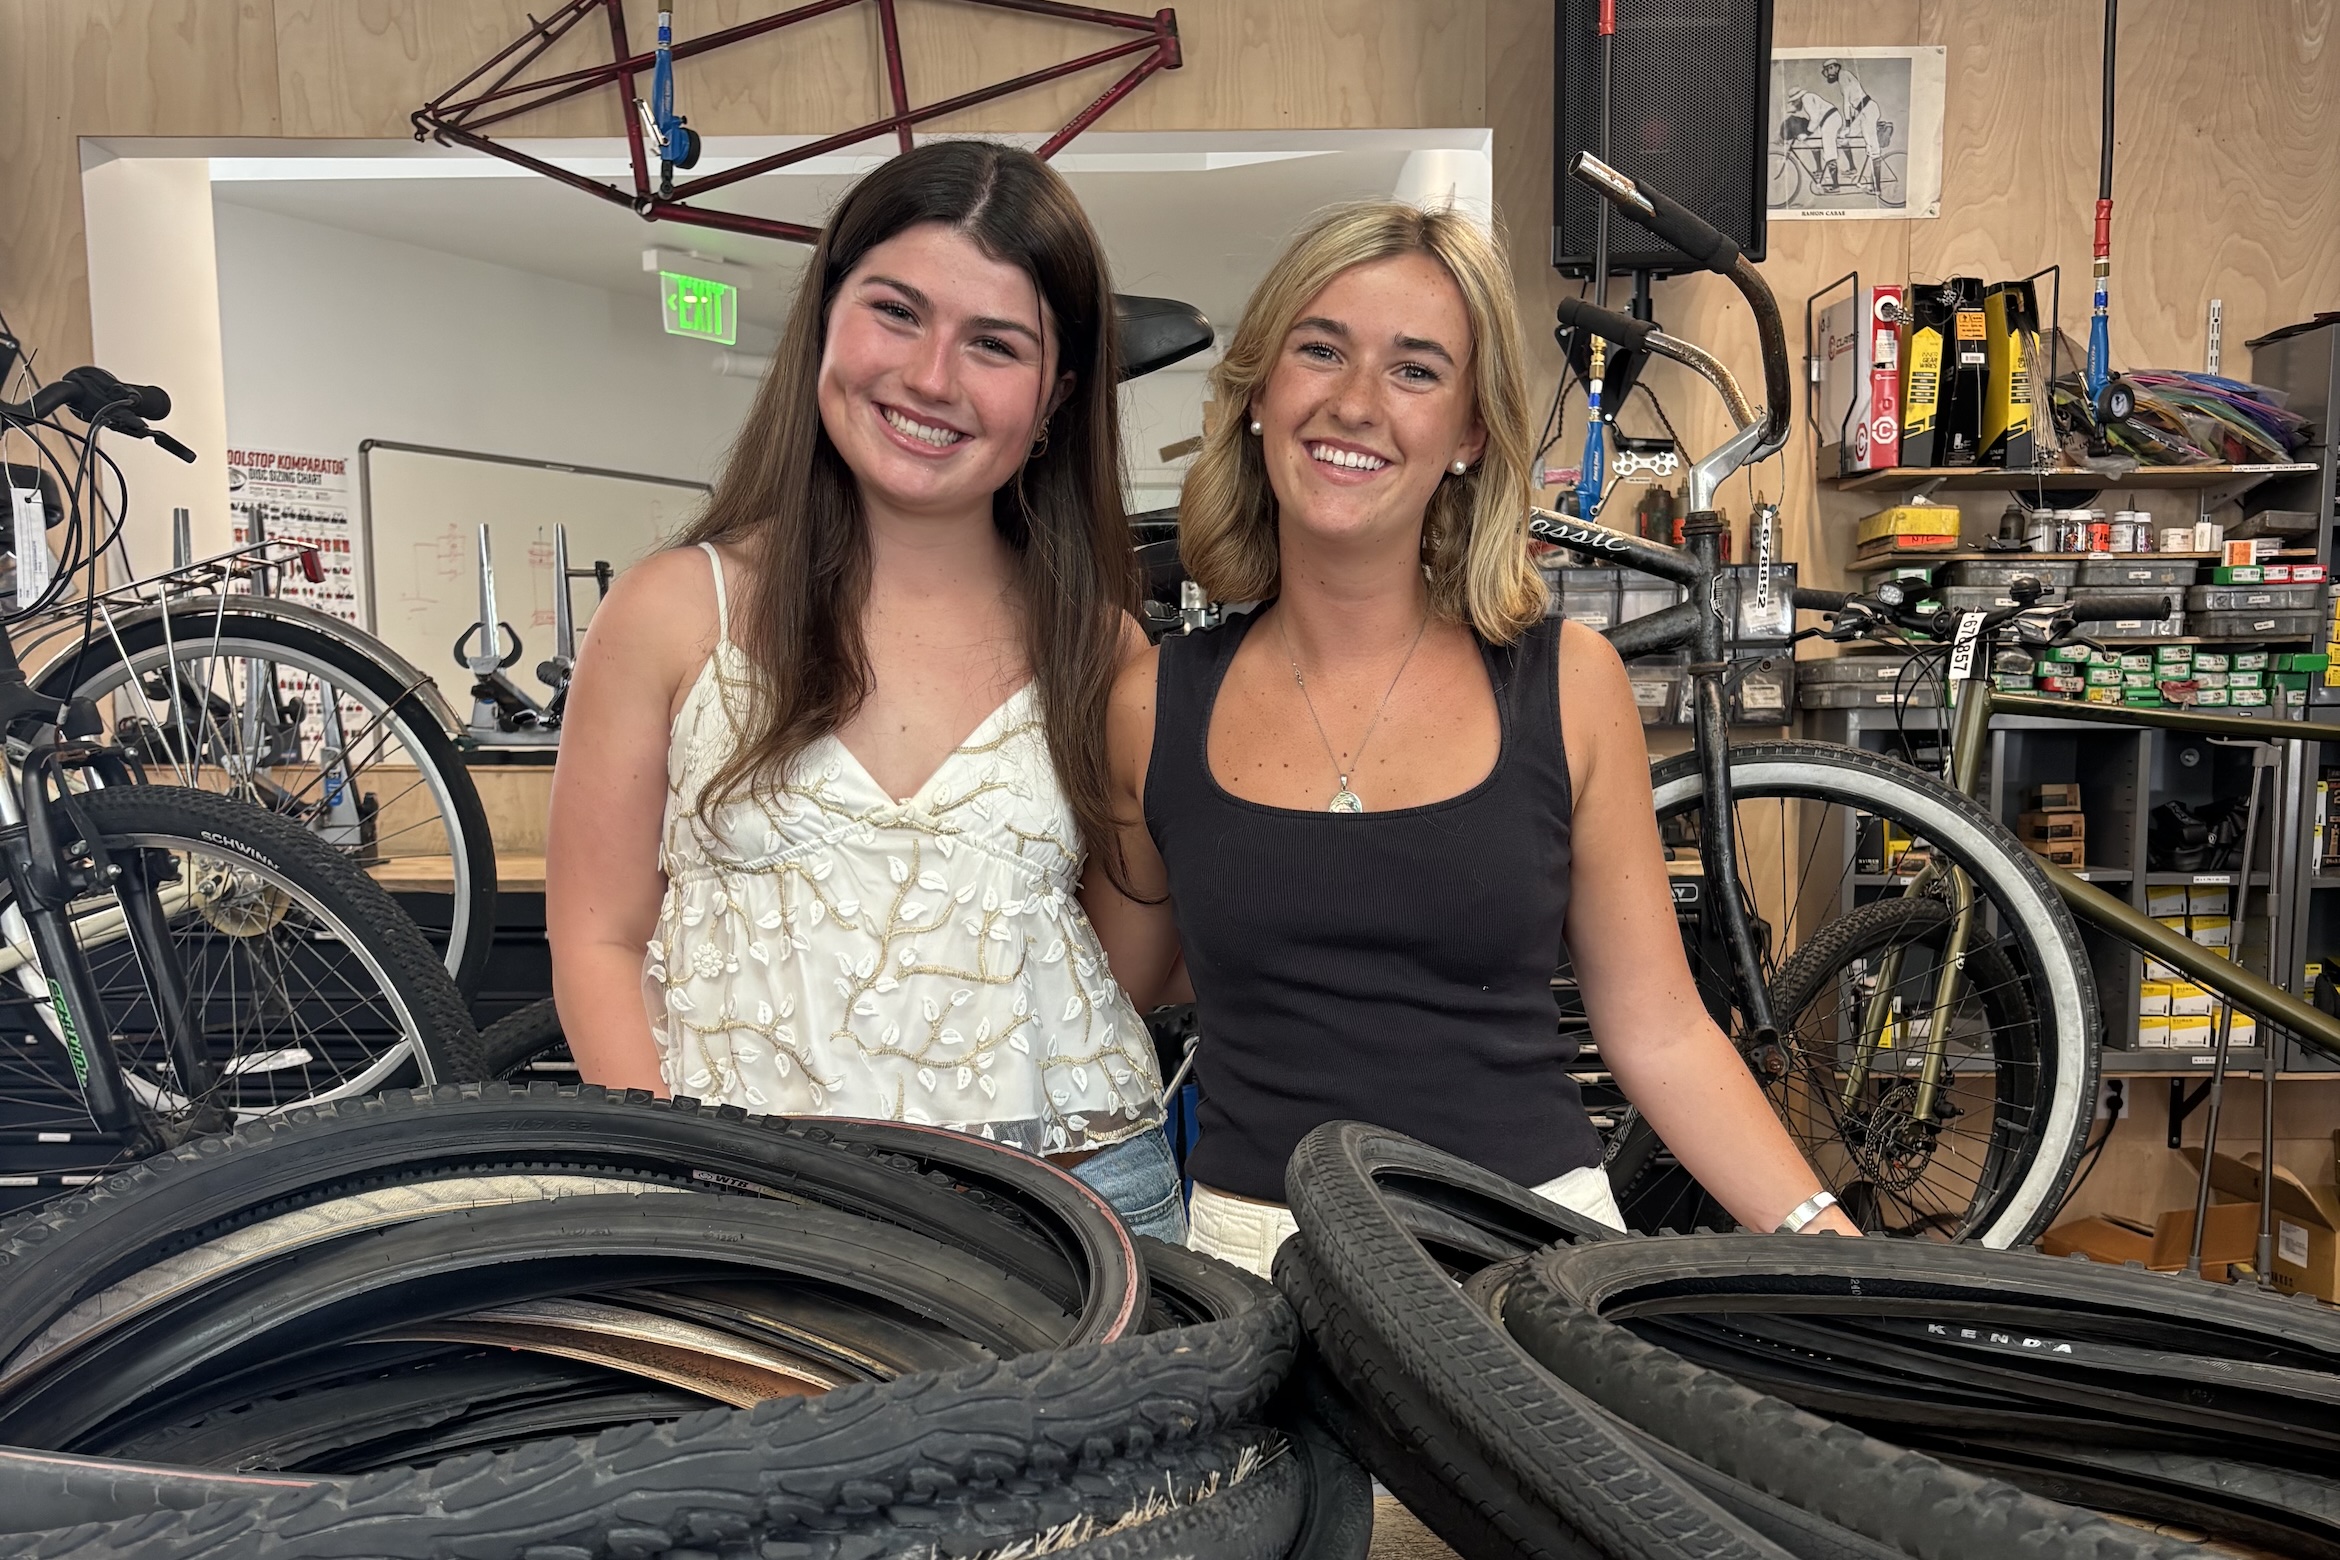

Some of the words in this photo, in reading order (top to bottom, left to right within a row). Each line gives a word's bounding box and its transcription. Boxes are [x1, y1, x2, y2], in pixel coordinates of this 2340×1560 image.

[679, 276, 725, 335] EXIT
[248, 467, 269, 480] DISC
[269, 469, 296, 483] SIZING
[296, 471, 322, 485] CHART
[277, 454, 346, 476] KOMPARATOR
[1529, 505, 1631, 551] assic
[1757, 528, 1770, 609] 678852
[200, 830, 281, 870] SCHWINN
[715, 1174, 749, 1188] WTB
[1927, 1323, 2073, 1354] KENDA
